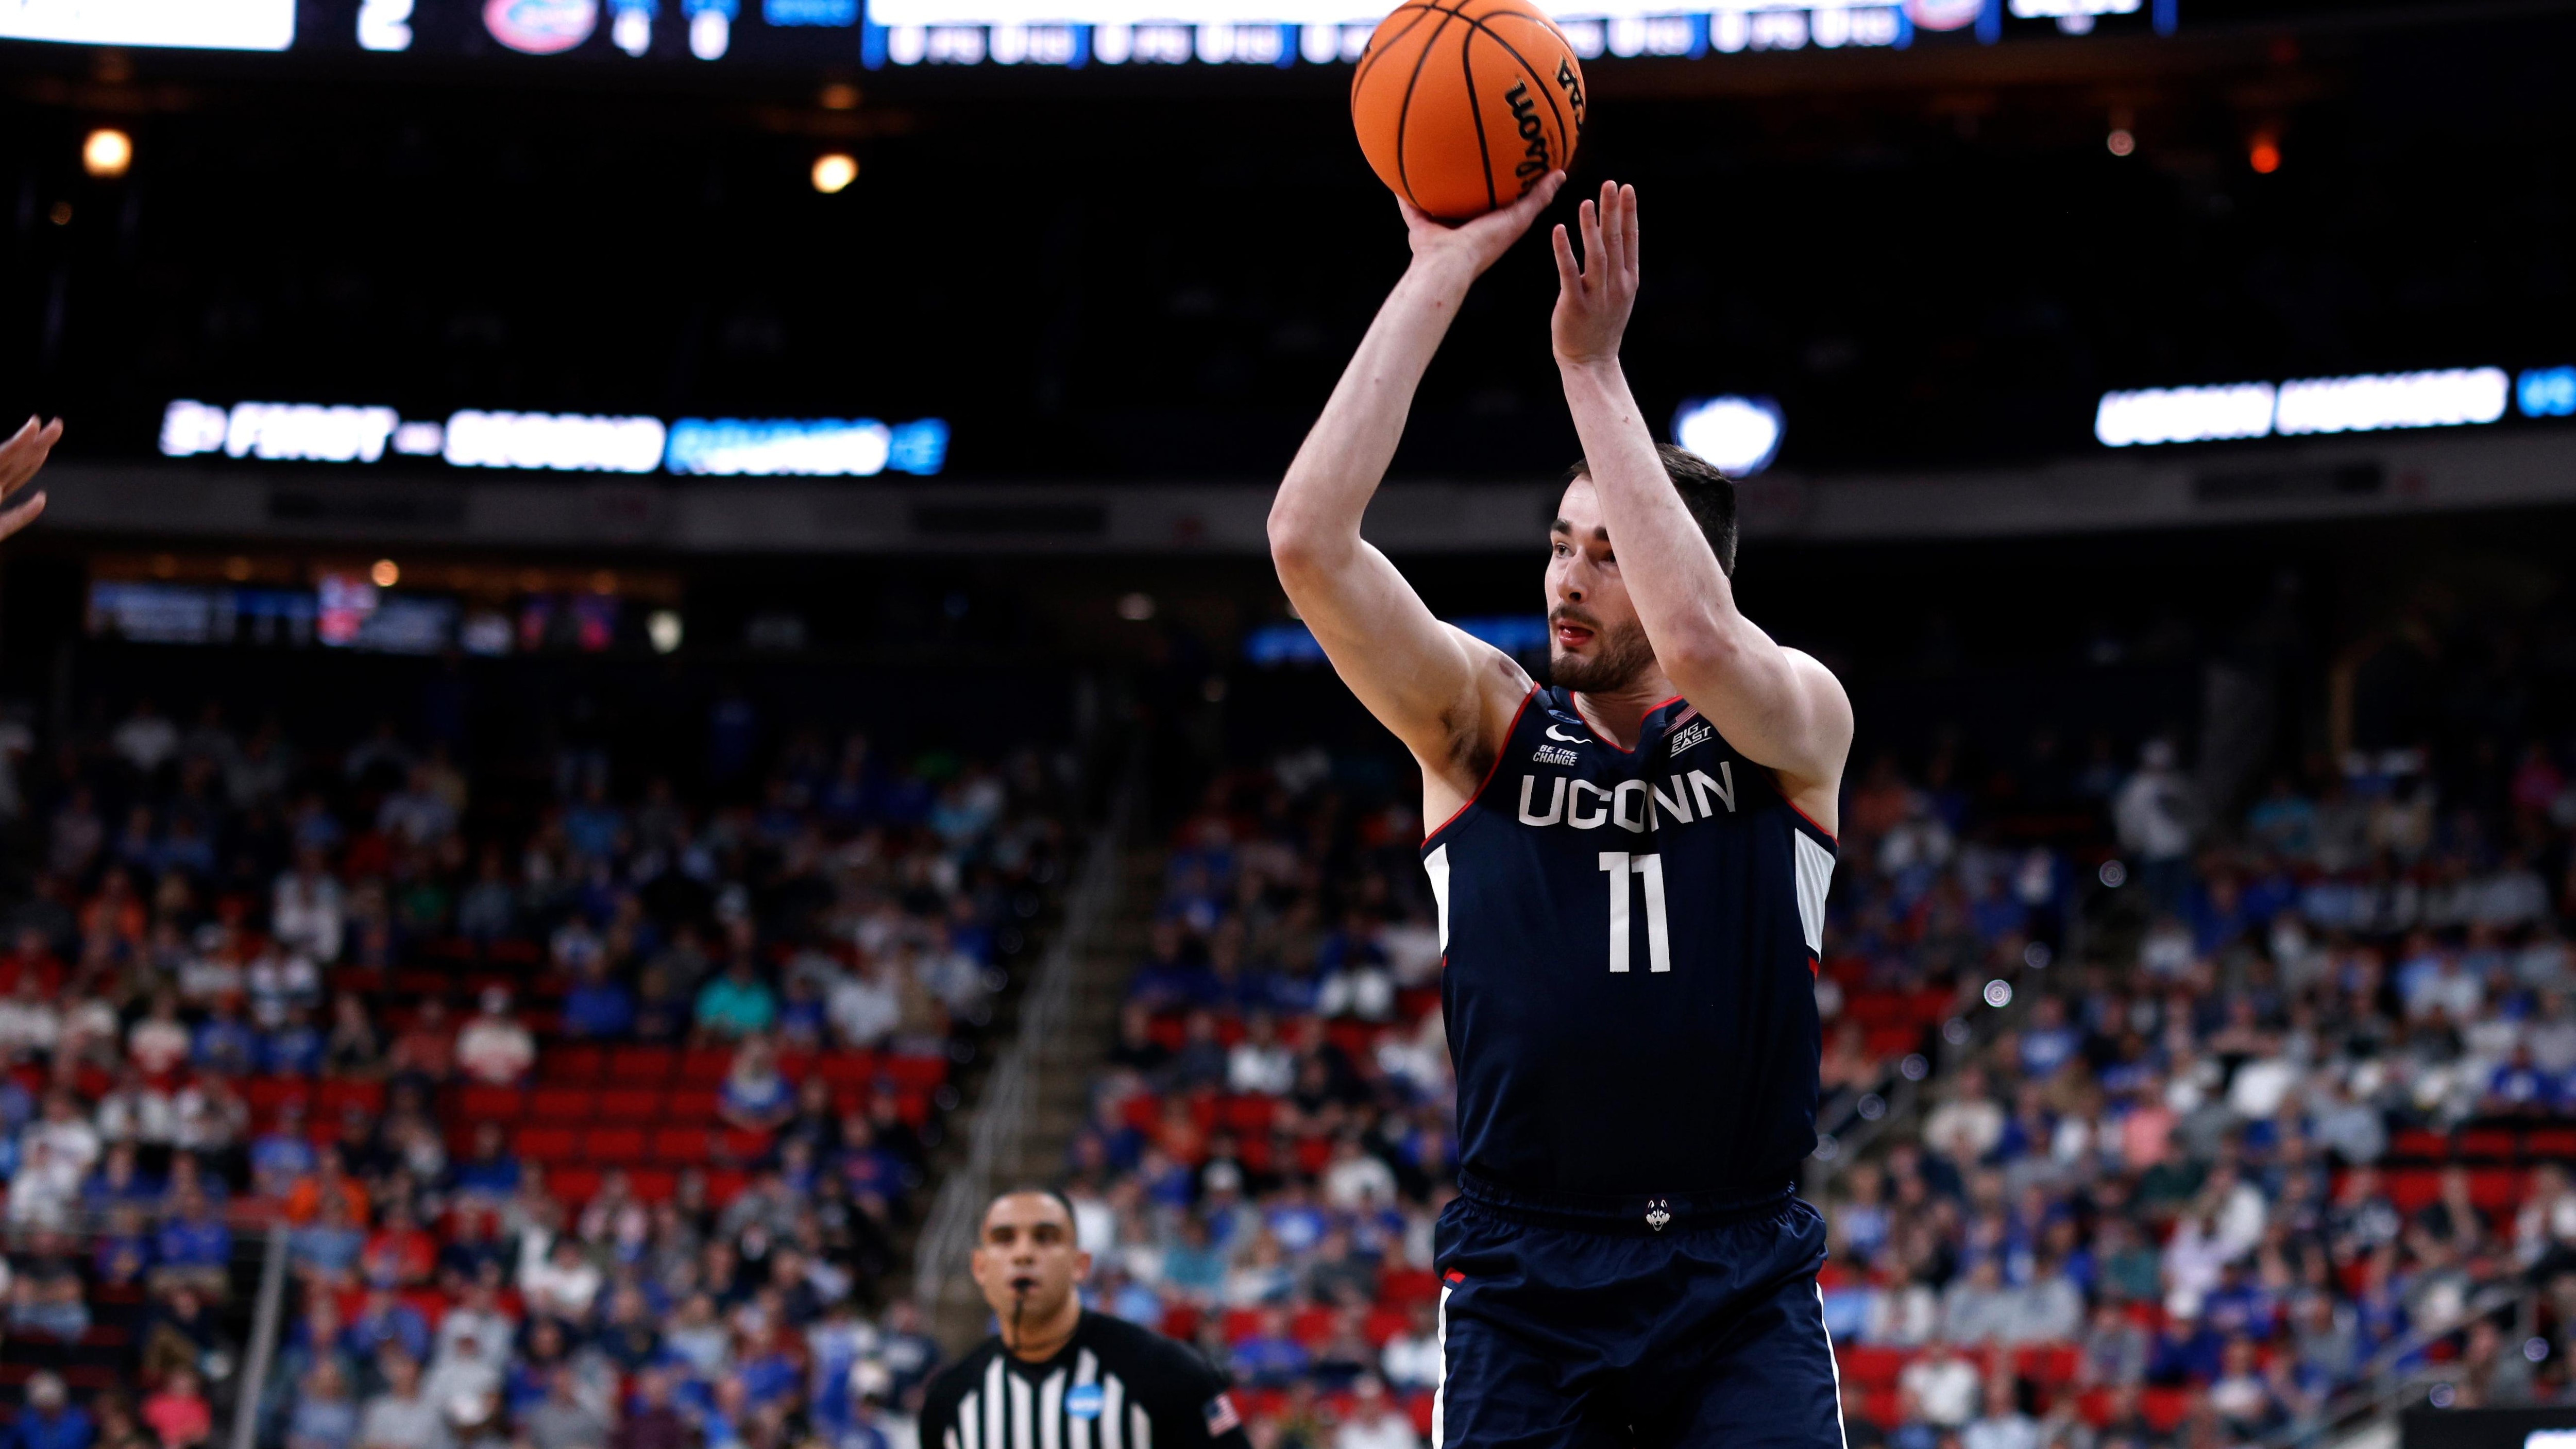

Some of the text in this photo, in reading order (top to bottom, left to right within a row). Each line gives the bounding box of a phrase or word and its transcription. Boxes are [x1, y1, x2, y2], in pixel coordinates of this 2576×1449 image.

[1504, 78, 1549, 200] ilson
[1671, 726, 1711, 753] EAST
[1672, 722, 1699, 744] BIG
[1532, 752, 1578, 766] CHANGE
[1539, 744, 1579, 756] BE THE
[1518, 761, 1736, 833] UCONN
[1599, 851, 1671, 973] 11
